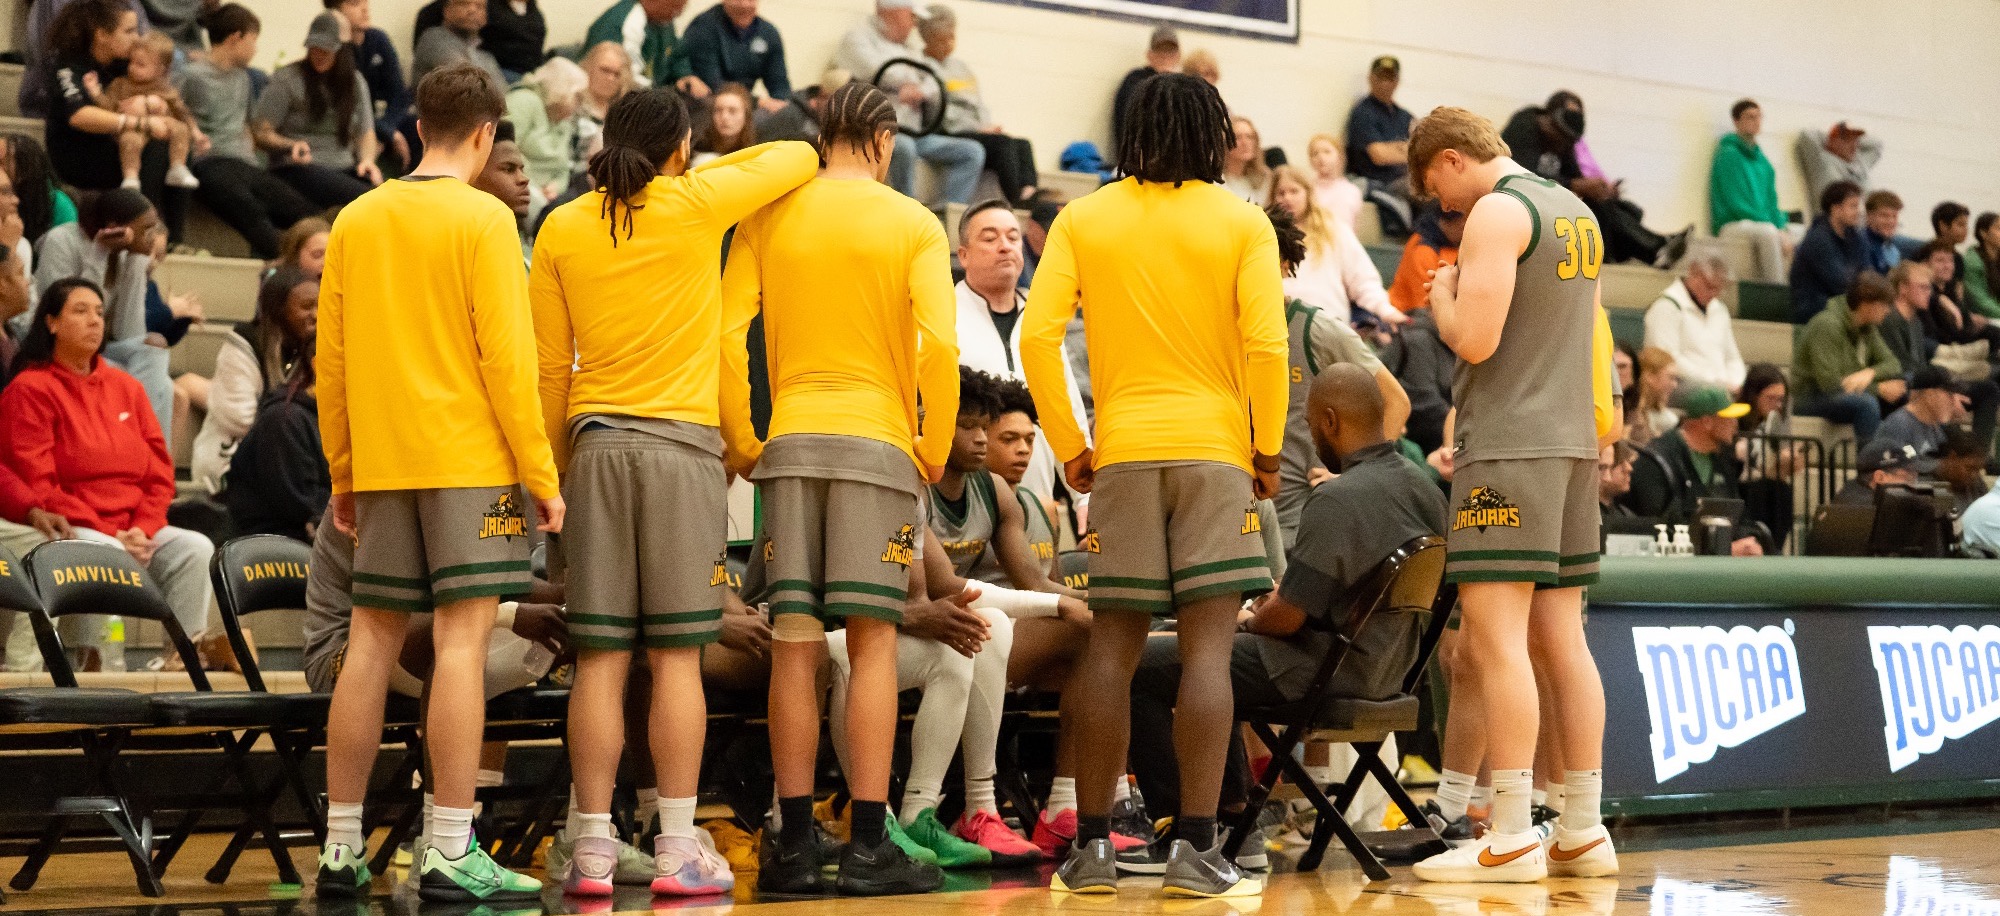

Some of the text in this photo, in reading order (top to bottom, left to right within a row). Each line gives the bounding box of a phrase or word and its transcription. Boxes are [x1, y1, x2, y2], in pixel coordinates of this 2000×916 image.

[1554, 217, 1604, 281] 30
[1452, 507, 1521, 532] JAGUARS
[881, 541, 913, 567] JAGUA
[53, 565, 143, 588] DANVILLE
[243, 562, 310, 582] DANVILL
[1646, 642, 1794, 761] NJCAA
